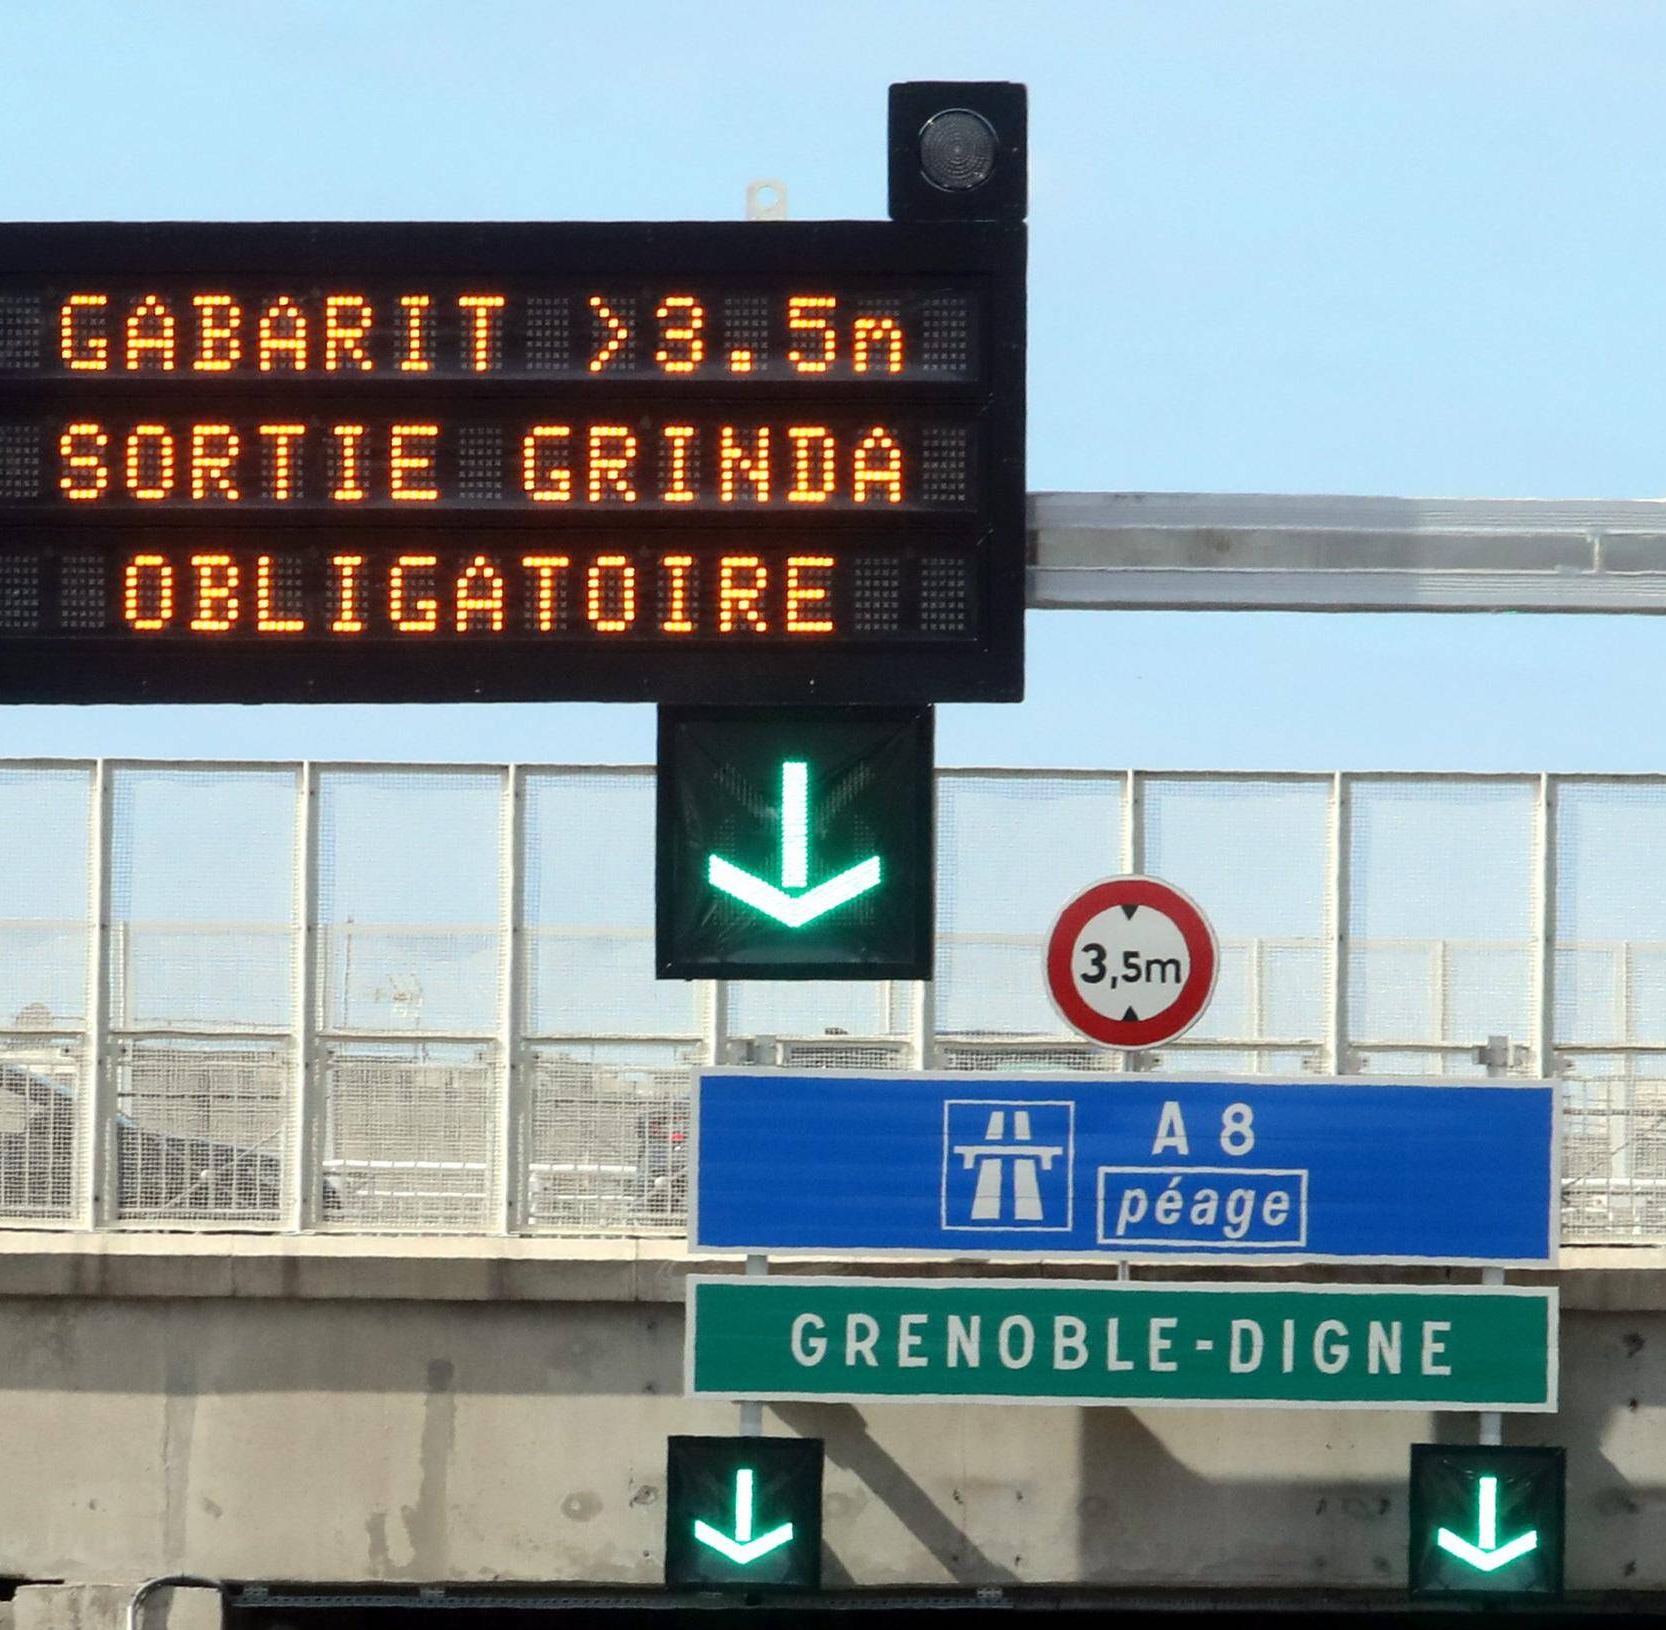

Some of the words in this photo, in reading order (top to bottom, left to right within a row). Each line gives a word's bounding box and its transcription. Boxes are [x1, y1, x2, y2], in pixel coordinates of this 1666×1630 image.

[58, 293, 505, 374] GABARIT
[58, 422, 440, 502] SORTIE
[522, 424, 903, 504] GRINDA
[123, 553, 836, 633] OBLIGATOIRE
[1079, 942, 1182, 990] 3,5m
[1151, 1101, 1189, 1156] A
[1219, 1101, 1256, 1157] 8
[1116, 1178, 1290, 1238] péage
[790, 1312, 1454, 1377] GRENOBLE-DIGNE
